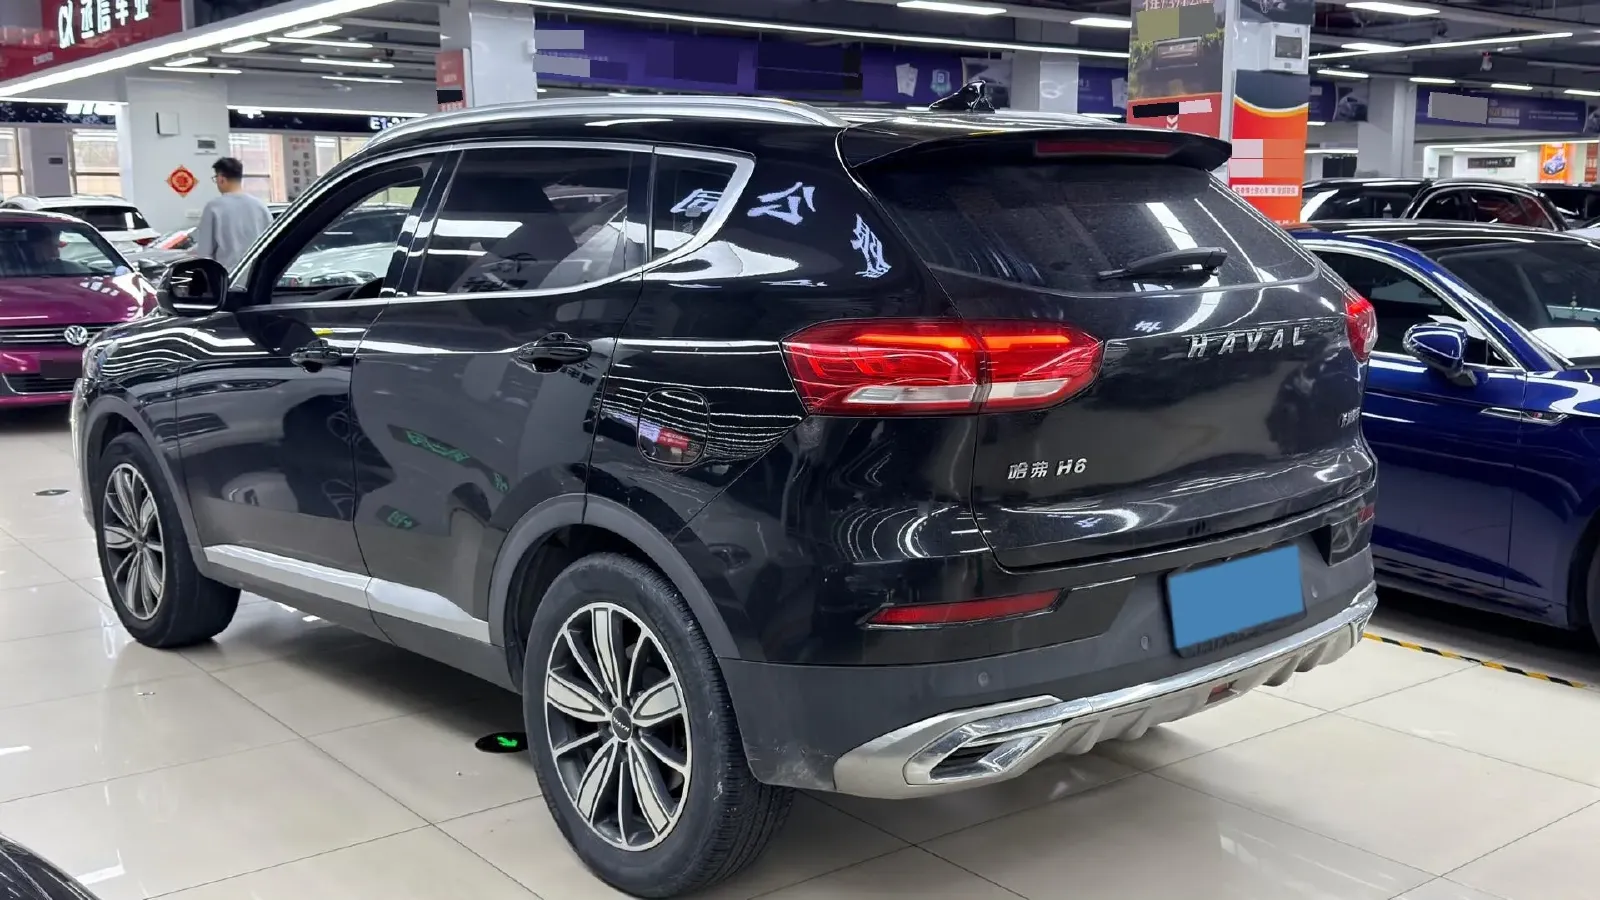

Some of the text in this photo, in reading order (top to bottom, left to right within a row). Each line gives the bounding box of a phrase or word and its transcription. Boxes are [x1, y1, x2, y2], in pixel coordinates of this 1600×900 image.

[1187, 326, 1305, 358] HAVAL
[1007, 457, 1088, 480] 哈弗 H6
